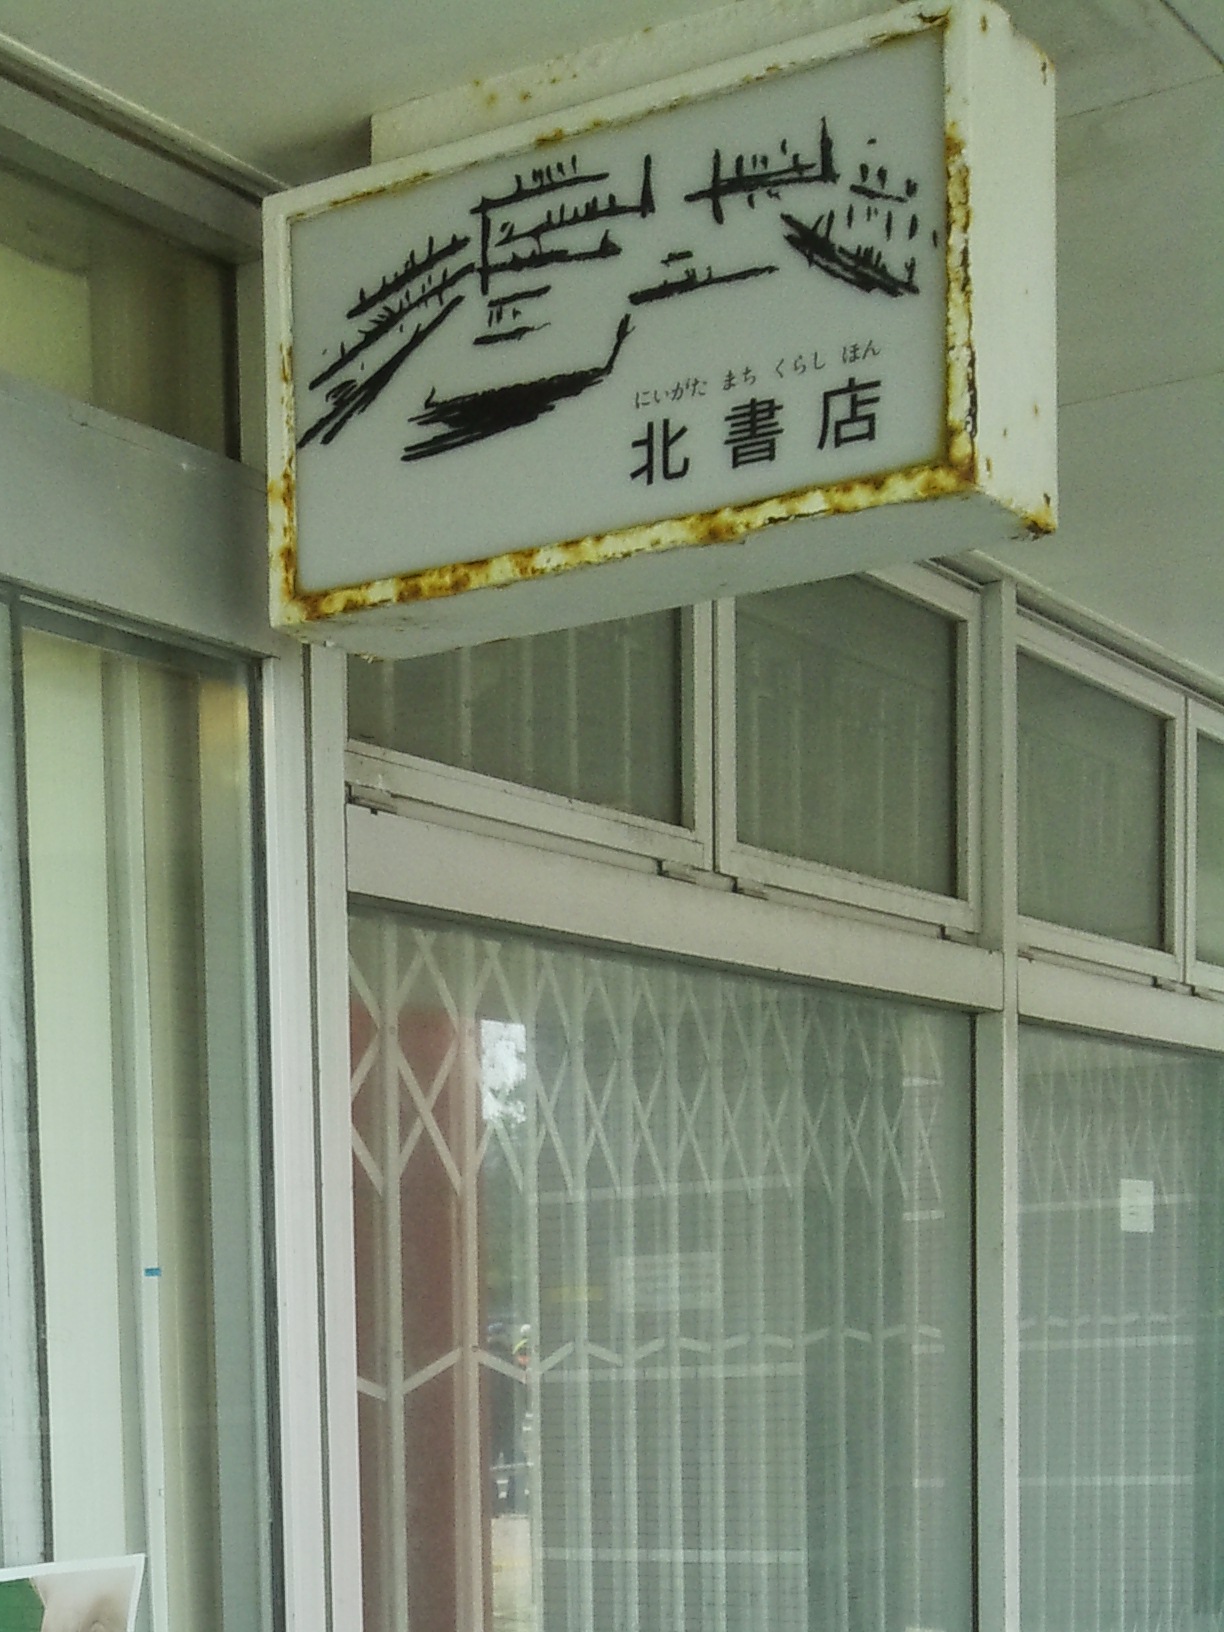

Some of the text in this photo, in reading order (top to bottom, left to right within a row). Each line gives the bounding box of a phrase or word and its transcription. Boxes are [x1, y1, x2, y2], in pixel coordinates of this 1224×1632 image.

[634, 339, 883, 410] にいがた まち くらし ほん
[630, 376, 883, 487] 北書店
